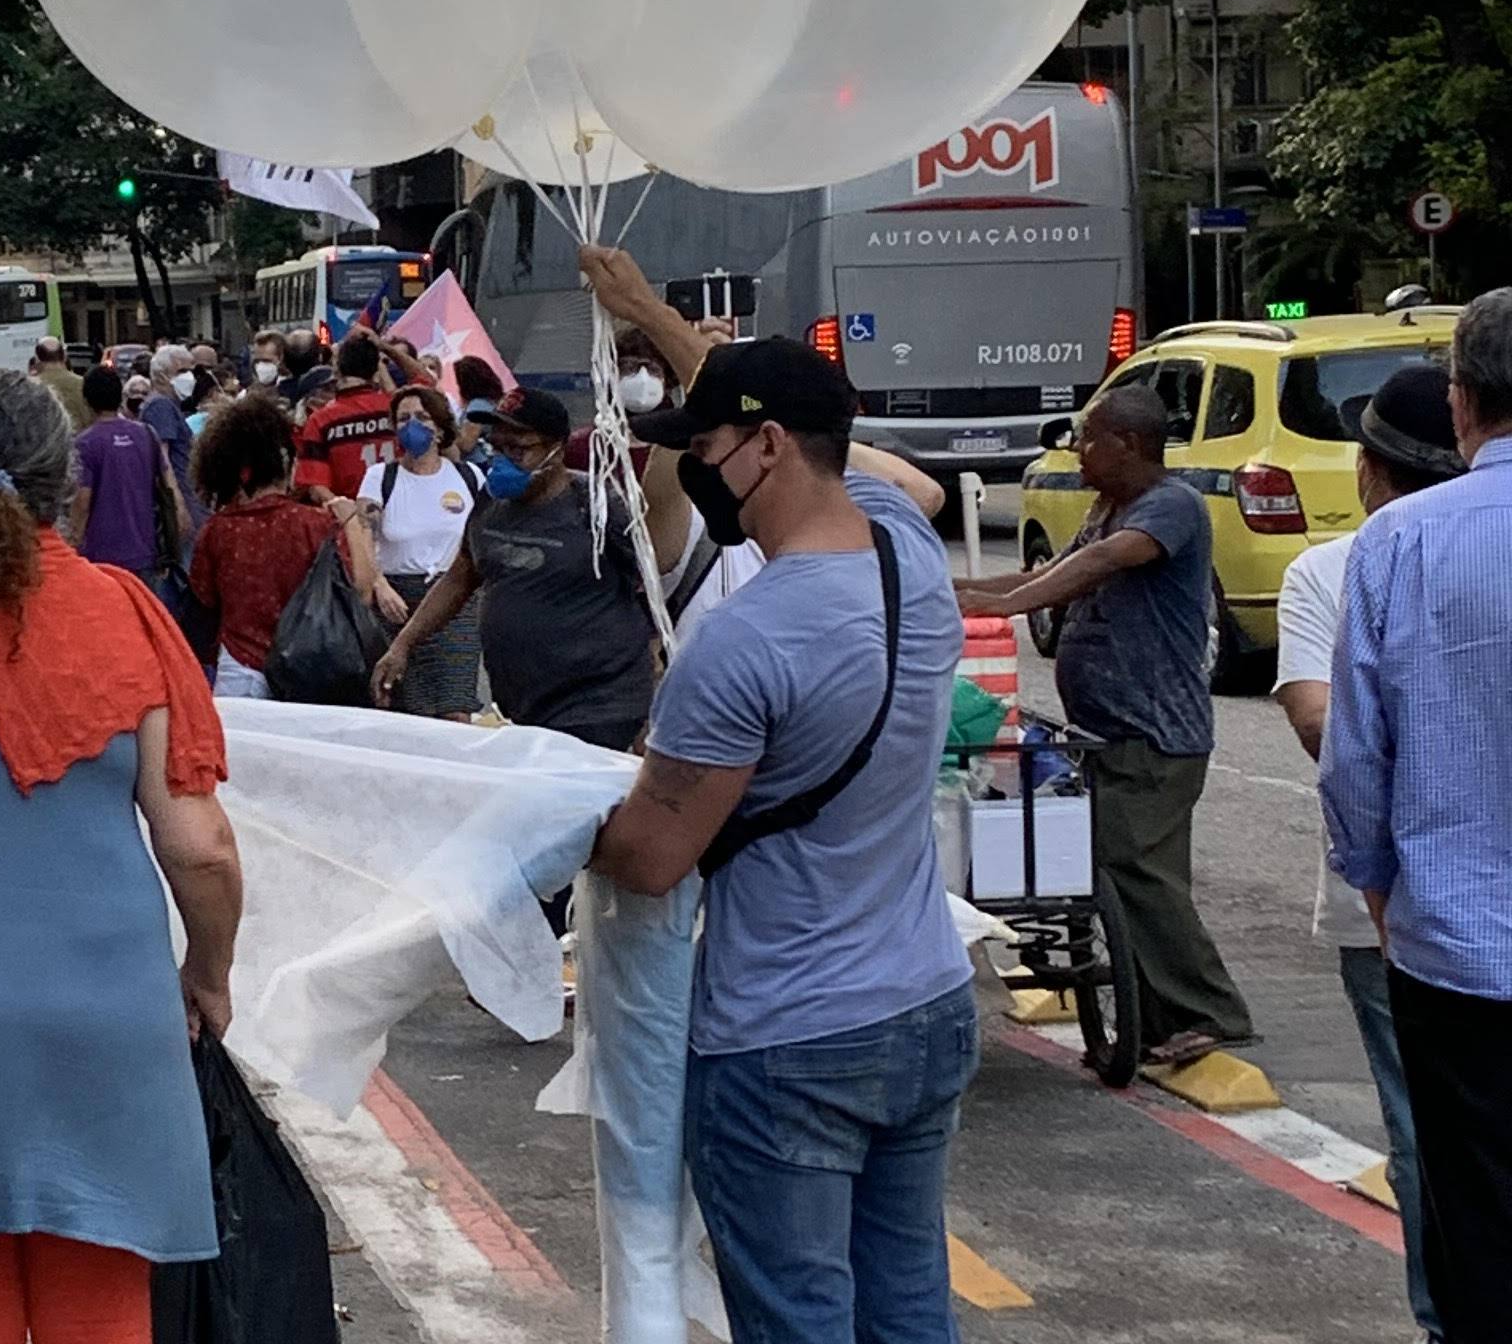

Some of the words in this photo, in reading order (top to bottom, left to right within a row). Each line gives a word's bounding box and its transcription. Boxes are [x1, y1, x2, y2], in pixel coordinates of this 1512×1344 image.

[913, 106, 1059, 195] 1001
[1424, 197, 1442, 224] E
[1266, 302, 1305, 318] TAXI
[978, 343, 1083, 364] RJ108.071
